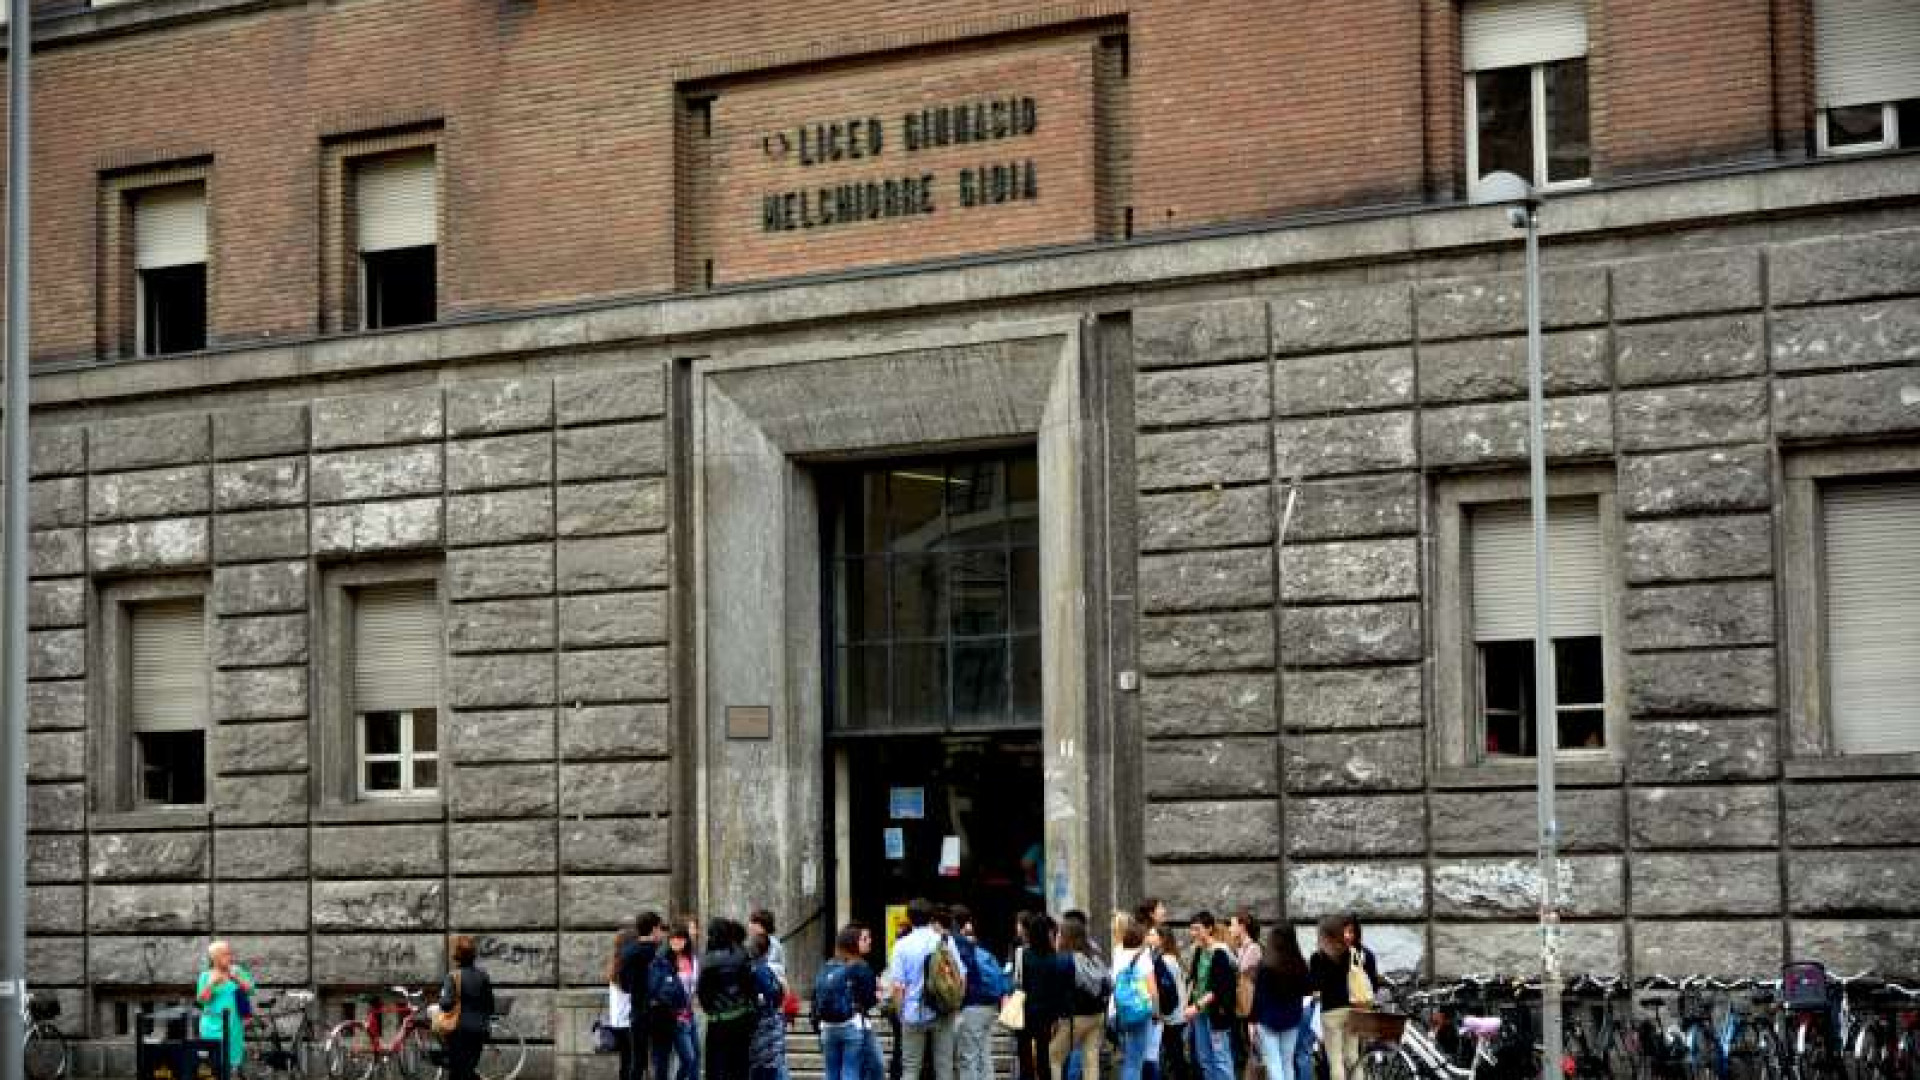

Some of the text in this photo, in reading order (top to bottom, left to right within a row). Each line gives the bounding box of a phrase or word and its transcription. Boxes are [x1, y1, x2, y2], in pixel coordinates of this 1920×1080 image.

[799, 96, 1037, 166] LICEO GINNASIO
[763, 159, 1037, 232] MELCHIORRE GIOIA
